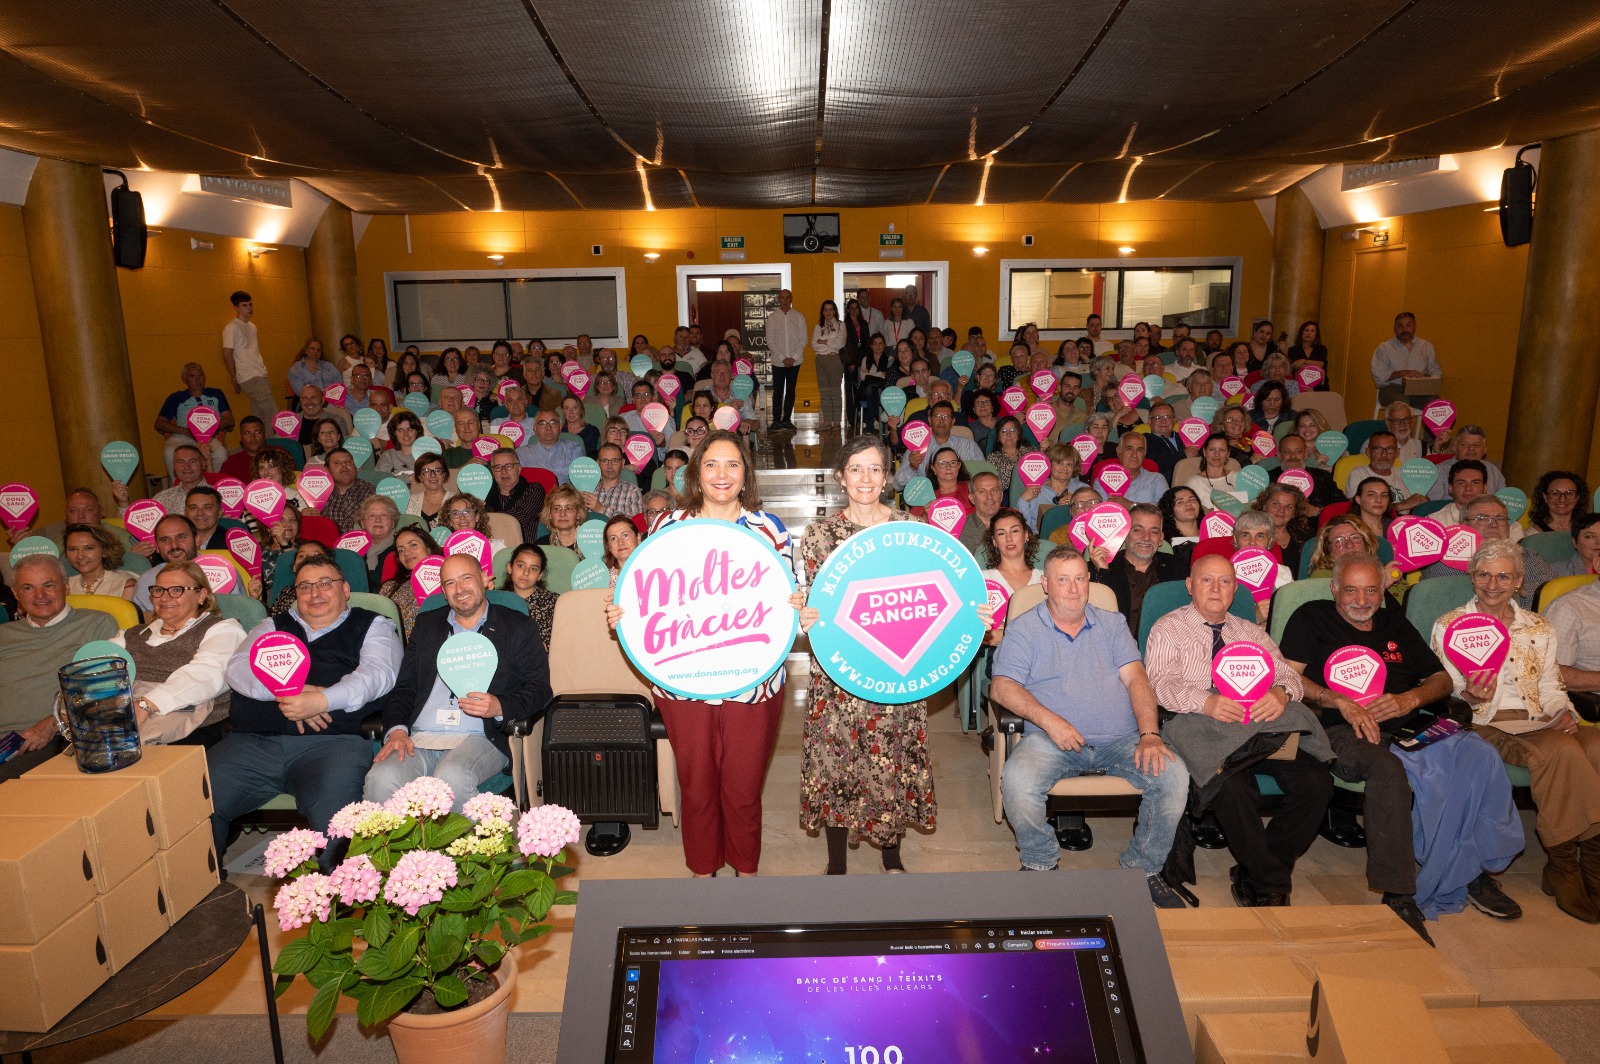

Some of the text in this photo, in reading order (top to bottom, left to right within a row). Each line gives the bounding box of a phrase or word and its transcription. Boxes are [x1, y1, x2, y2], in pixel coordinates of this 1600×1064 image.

[1412, 535, 1430, 550] SANG
[1415, 532, 1434, 546] DONA
[1448, 538, 1466, 552] DONA
[1454, 542, 1470, 556] SANG
[821, 532, 967, 597] MISIÓN CUMPLIDA
[1241, 562, 1262, 572] DONA
[589, 567, 605, 578] REGAL
[1243, 568, 1263, 576] SANG
[634, 548, 770, 618] Moltes
[868, 588, 928, 608] DONA
[859, 603, 939, 627] SANGRE
[643, 602, 772, 654] Gràcies
[1461, 634, 1490, 643] DONA
[1464, 641, 1490, 650] SANG
[267, 653, 292, 661] DONA
[441, 651, 493, 664] GRAN REGAL
[830, 632, 973, 694] WWW.DONASANG.ORG
[668, 667, 759, 680] www.donasang.org
[1340, 664, 1366, 676] DONA
[1344, 670, 1368, 681] SANG
[844, 1045, 903, 1064] 100
